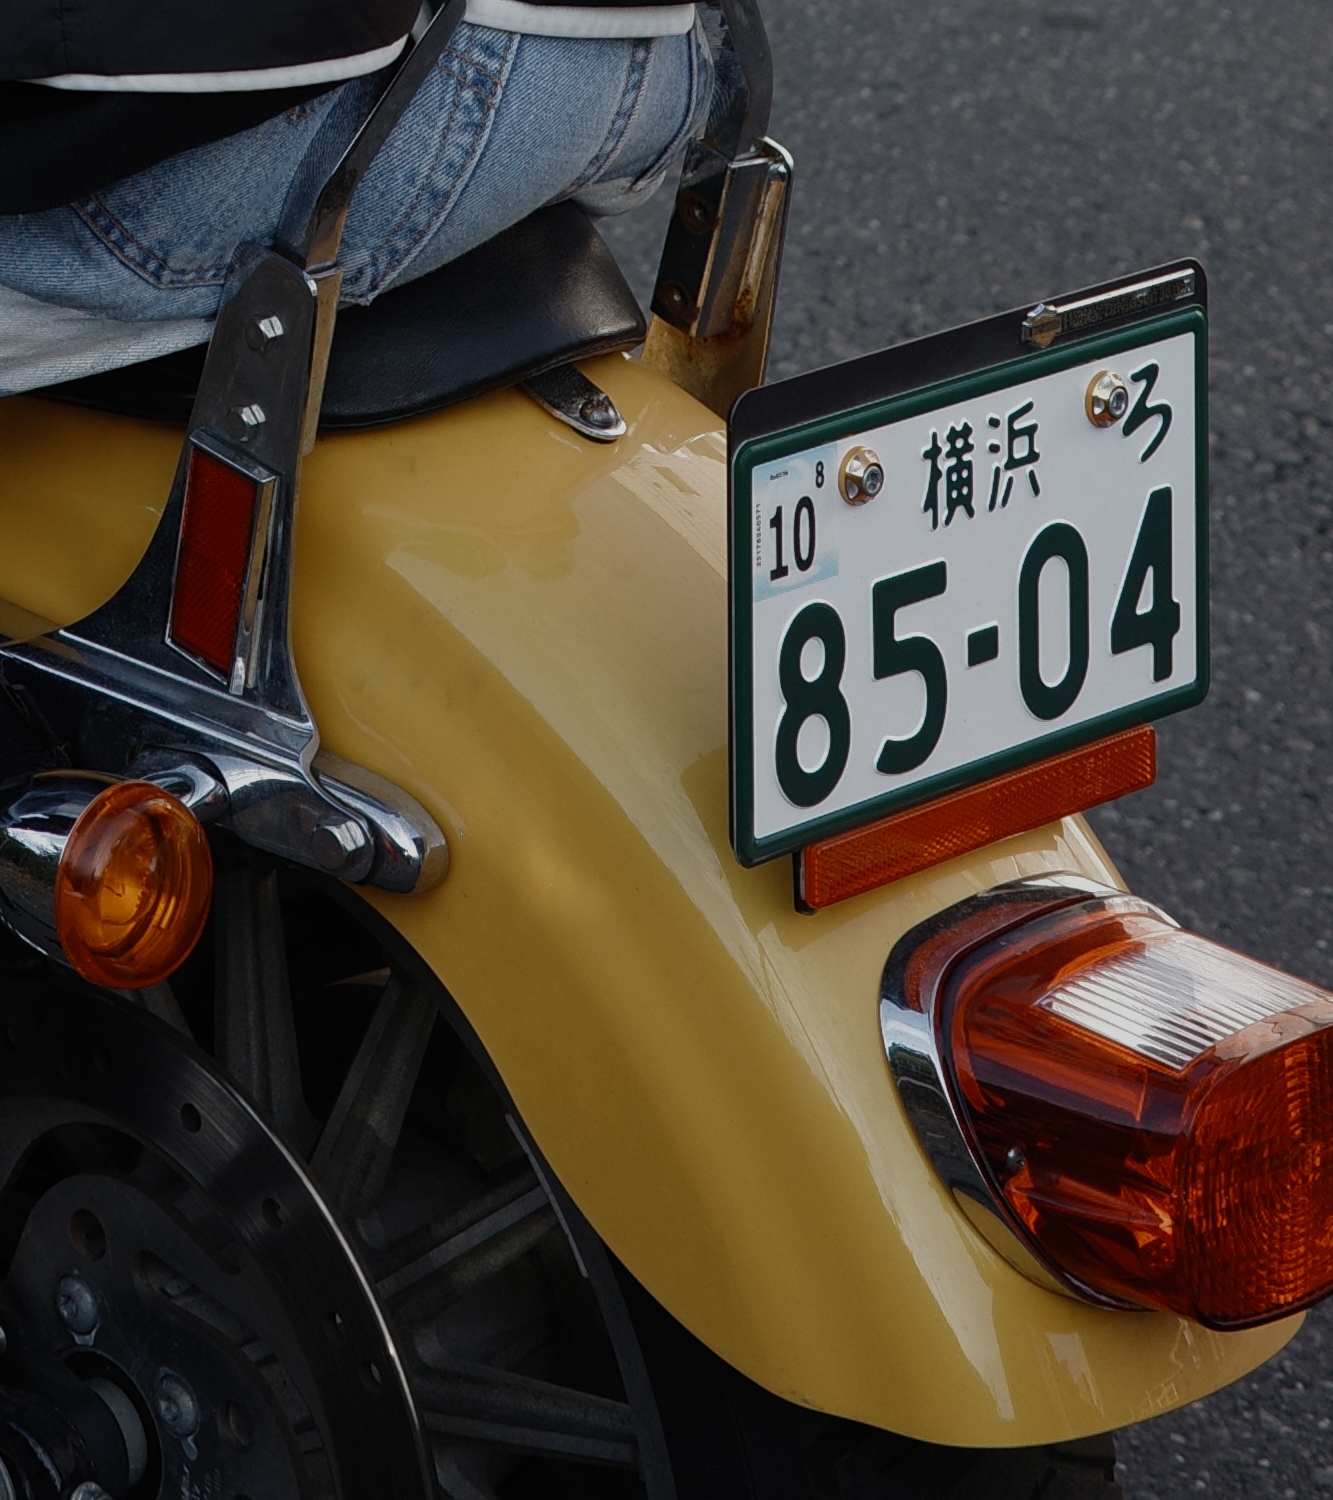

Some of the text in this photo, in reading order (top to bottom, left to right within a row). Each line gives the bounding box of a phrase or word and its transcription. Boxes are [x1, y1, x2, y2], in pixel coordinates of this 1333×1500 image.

[815, 460, 824, 489] 8
[922, 360, 1172, 530] 横浜 ろ
[769, 496, 816, 582] 10
[775, 485, 1181, 808] 85-04
